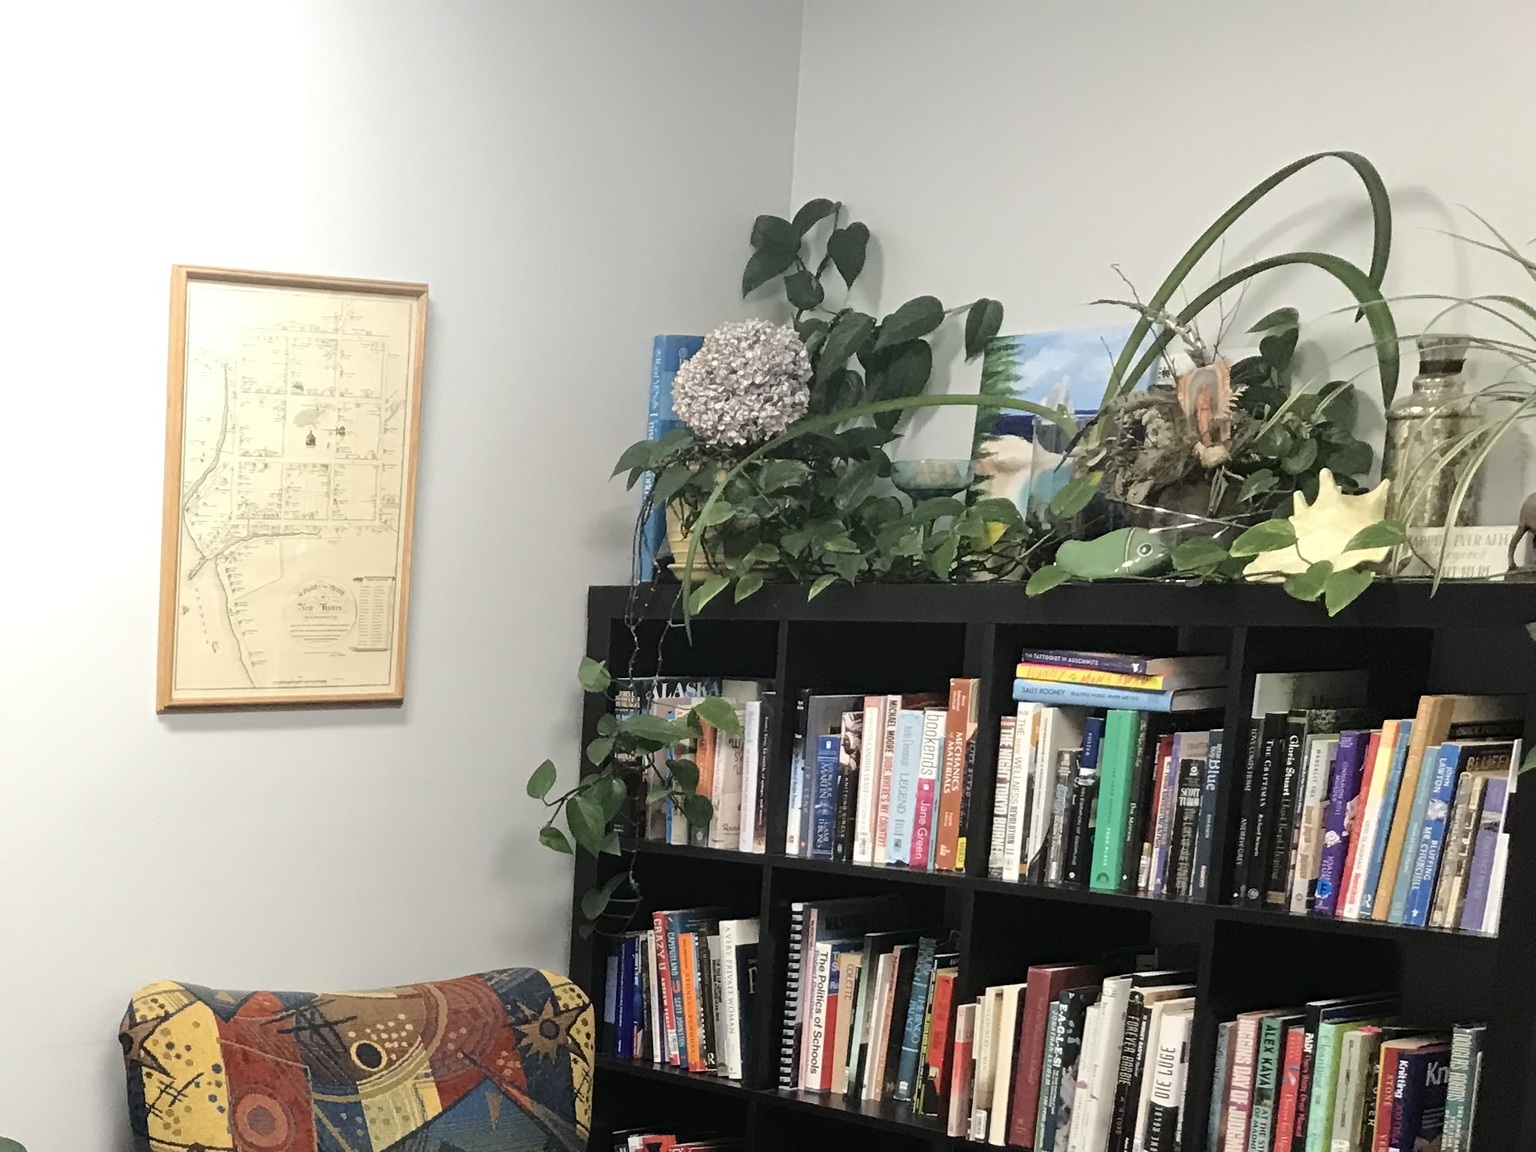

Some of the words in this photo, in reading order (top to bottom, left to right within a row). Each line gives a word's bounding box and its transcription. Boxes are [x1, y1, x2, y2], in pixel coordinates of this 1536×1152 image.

[1033, 654, 1061, 662] TATTOOIST
[1068, 656, 1098, 666] AUSCHWITZ
[651, 681, 721, 698] ALASKA
[886, 700, 898, 728] MICHAEL
[1018, 719, 1026, 736] THE
[884, 730, 896, 753] MOORE
[920, 714, 942, 776] bookends
[1001, 728, 1014, 746] THE
[1249, 728, 1258, 744] LOVE
[1264, 739, 1274, 758] THE
[1285, 734, 1300, 766] Gloria
[943, 740, 954, 794] MATERIALS
[952, 732, 964, 792] MECHANICS
[998, 748, 1012, 780] NIGHT
[1246, 746, 1256, 769] COMES
[818, 764, 826, 800] MARTIN
[1010, 756, 1023, 805] WELLNESS
[1206, 759, 1221, 791] Blue
[1244, 770, 1254, 792] HOME
[1258, 760, 1272, 807] CRAFTSMAN
[1282, 766, 1294, 796] Stuart
[1337, 762, 1349, 800] CINNAMON
[1432, 758, 1447, 794] LAWTON
[1443, 766, 1452, 787] JOHN
[897, 773, 909, 814] LEGEND
[994, 783, 1010, 814] TOKYO
[1180, 788, 1200, 796] SCOTT
[920, 800, 930, 825] Jane
[1007, 806, 1018, 844] REVOLUTION
[1280, 803, 1289, 821] Just
[1335, 802, 1344, 816] ROLL
[877, 816, 888, 848] COUNTRY?
[914, 827, 928, 860] Green
[1238, 818, 1248, 846] ANDREW
[1275, 824, 1286, 844] Kept
[1422, 826, 1432, 842] MR.
[1236, 846, 1244, 866] GREY
[1272, 846, 1284, 880] Hoping
[1411, 844, 1428, 890] CHURCHILL
[1424, 840, 1438, 881] BLUFFING
[653, 918, 664, 958] CRAZY
[659, 963, 666, 971] U
[668, 932, 678, 976] CAMPUSLAND
[726, 958, 734, 994] PRIVATE
[819, 951, 828, 972] The
[816, 974, 827, 1014] Politics
[844, 963, 854, 1000] COLETTE
[728, 998, 736, 1034] WOMAN
[814, 1017, 821, 1028] of
[906, 1000, 916, 1032] PALACE
[912, 1013, 926, 1045] BINGO
[1048, 1010, 1059, 1052] JONATHAN
[1054, 1004, 1068, 1066] E-A-G-L-E-S!
[1124, 1015, 1140, 1053] FOREVER
[1234, 1019, 1255, 1064] HIGGINS
[1262, 1024, 1276, 1056] ALEX
[1304, 1032, 1314, 1053] PADI
[810, 1030, 822, 1075] Schools
[1450, 1034, 1472, 1068] DOUGLAS
[1118, 1055, 1134, 1086] BARBIE
[1231, 1066, 1252, 1089] DAY
[1259, 1057, 1273, 1088] KAVA
[1394, 1060, 1408, 1099] Knitting
[1154, 1080, 1172, 1100] DIE
[1230, 1090, 1248, 1104] OF
[1384, 1074, 1394, 1106] STONE
[1254, 1108, 1262, 1118] OF
[1264, 1108, 1272, 1120] AT
[1284, 1094, 1293, 1120] Flowers
[1262, 1120, 1270, 1137] THE
[1282, 1122, 1291, 1132] for
